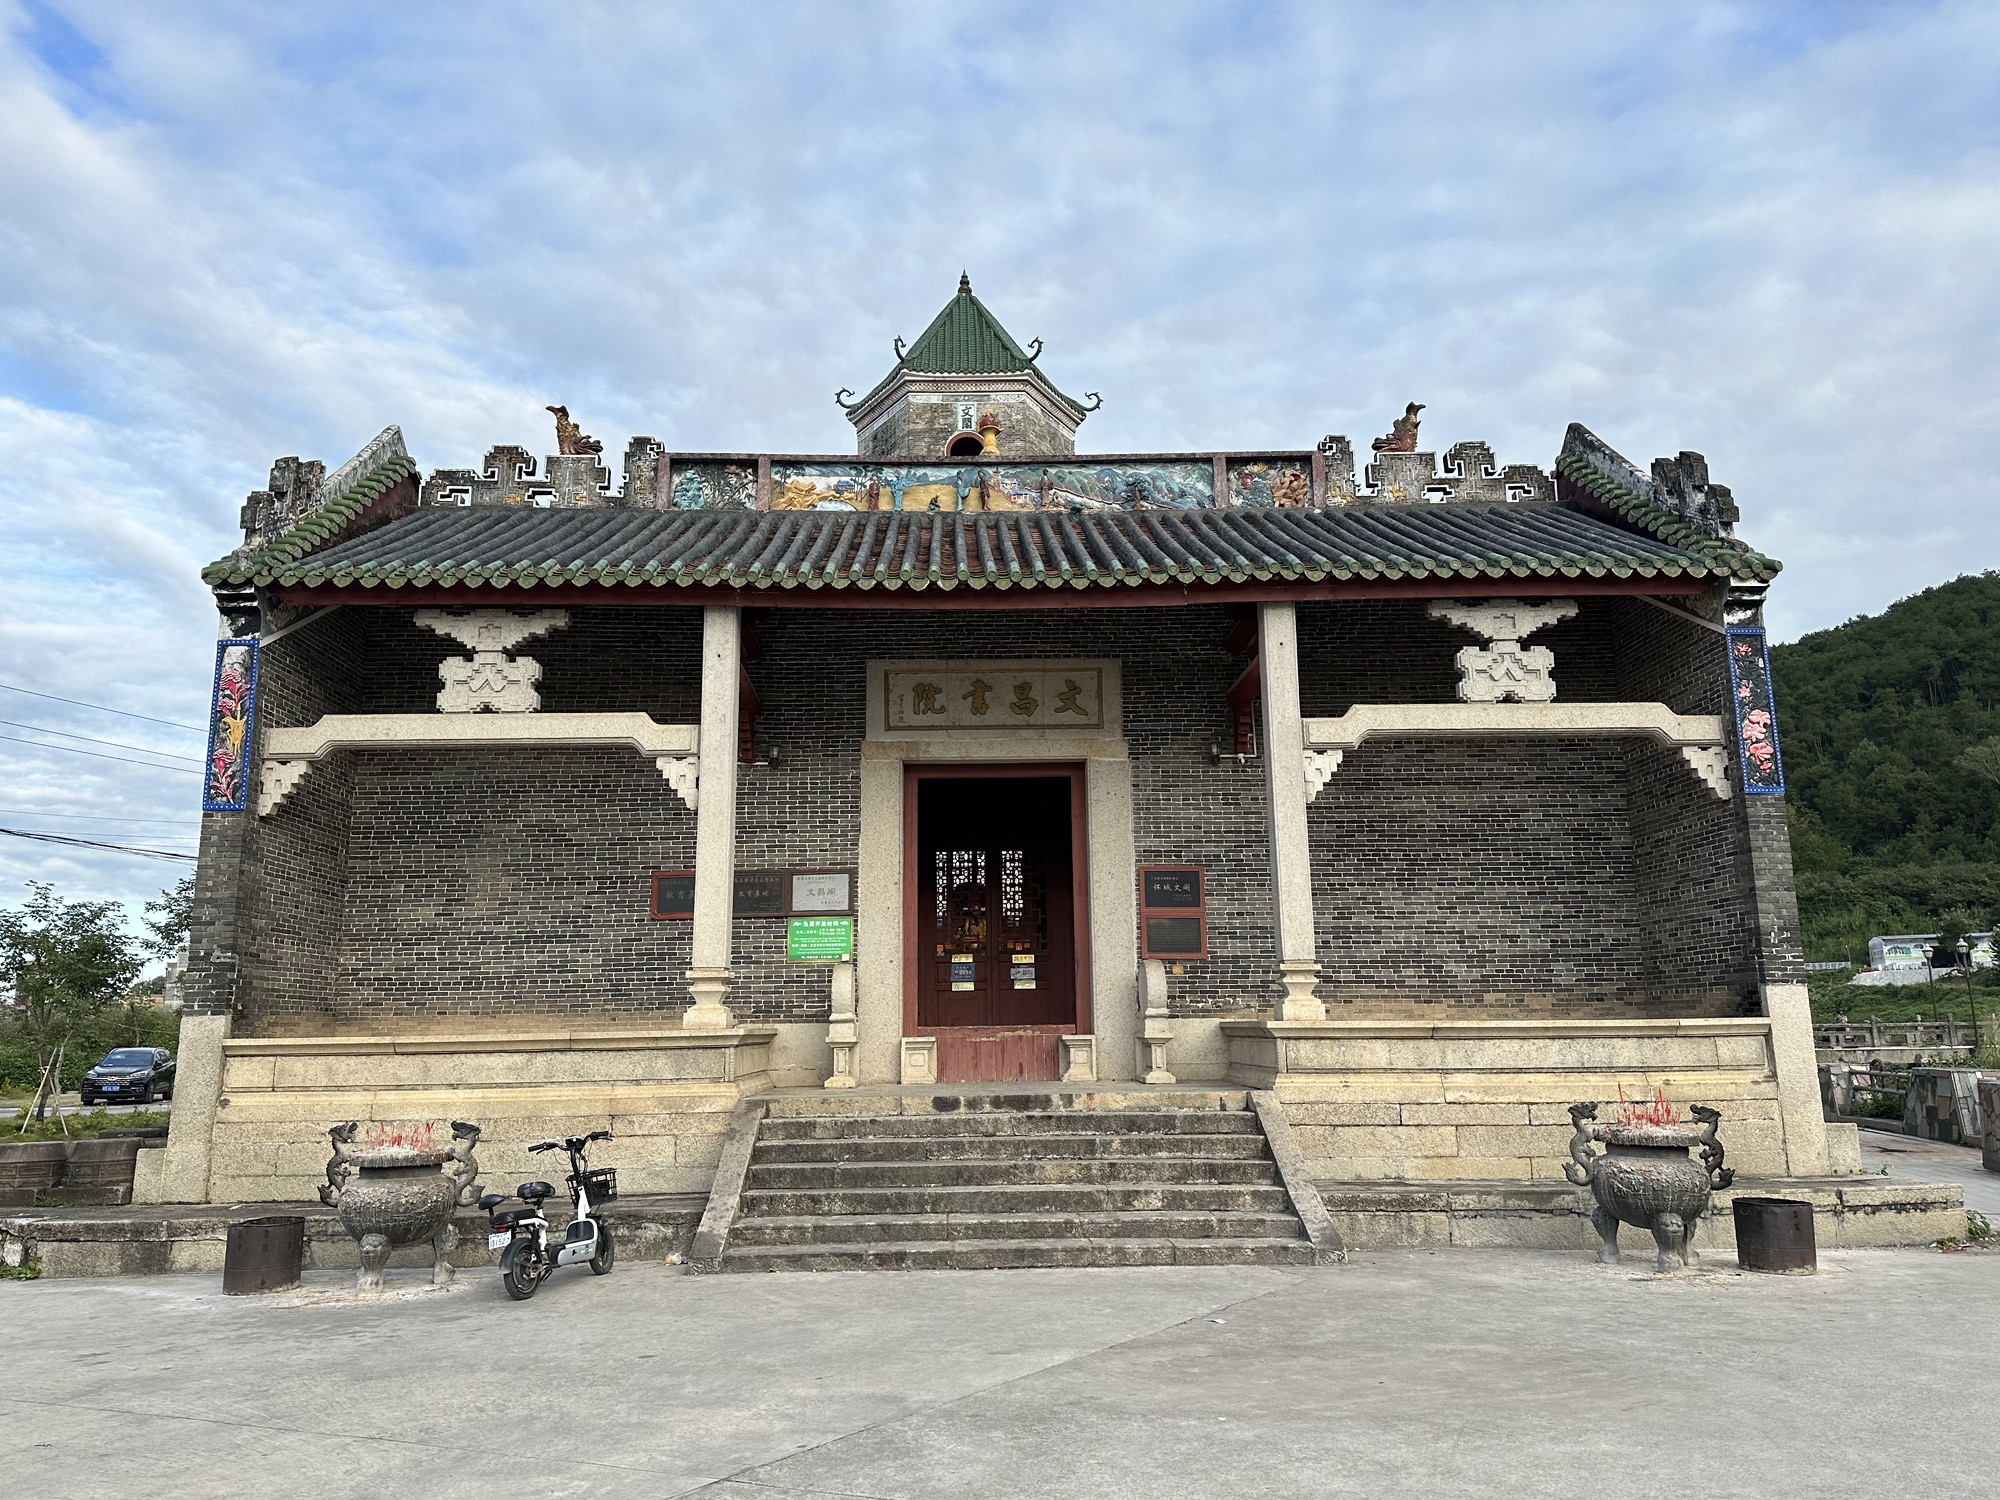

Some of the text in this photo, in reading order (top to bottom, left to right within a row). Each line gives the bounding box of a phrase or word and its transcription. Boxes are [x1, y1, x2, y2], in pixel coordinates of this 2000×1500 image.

[803, 920, 839, 928] 免费开放时间
